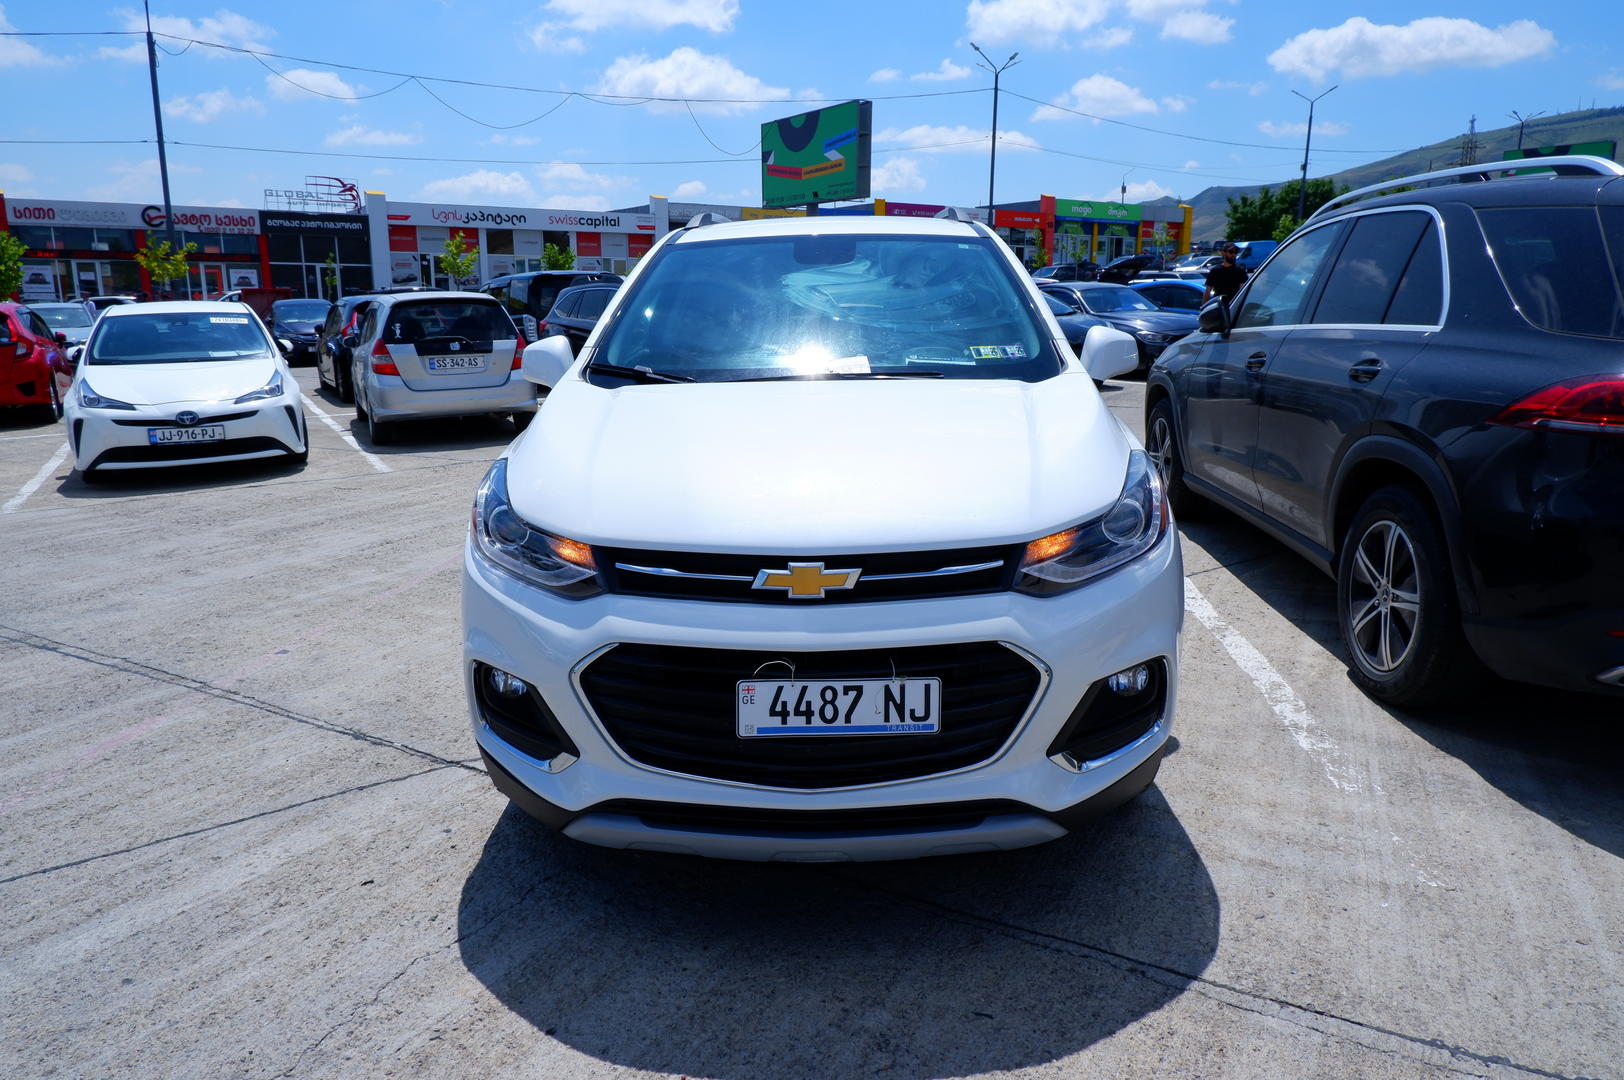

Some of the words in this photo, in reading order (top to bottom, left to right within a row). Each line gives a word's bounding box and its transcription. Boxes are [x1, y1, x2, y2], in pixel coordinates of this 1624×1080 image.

[264, 189, 324, 200] GLOBAL
[12, 206, 56, 220] სითი
[1071, 205, 1093, 217] mogo
[173, 213, 212, 226] ავტო
[215, 214, 256, 227] სესხი
[436, 357, 479, 368] SS-342-AS
[159, 428, 216, 441] JJ-916-PJ
[742, 695, 756, 705] GE
[769, 685, 864, 726] 4487
[883, 683, 932, 723] NJ
[886, 724, 923, 732] TRANSIT
